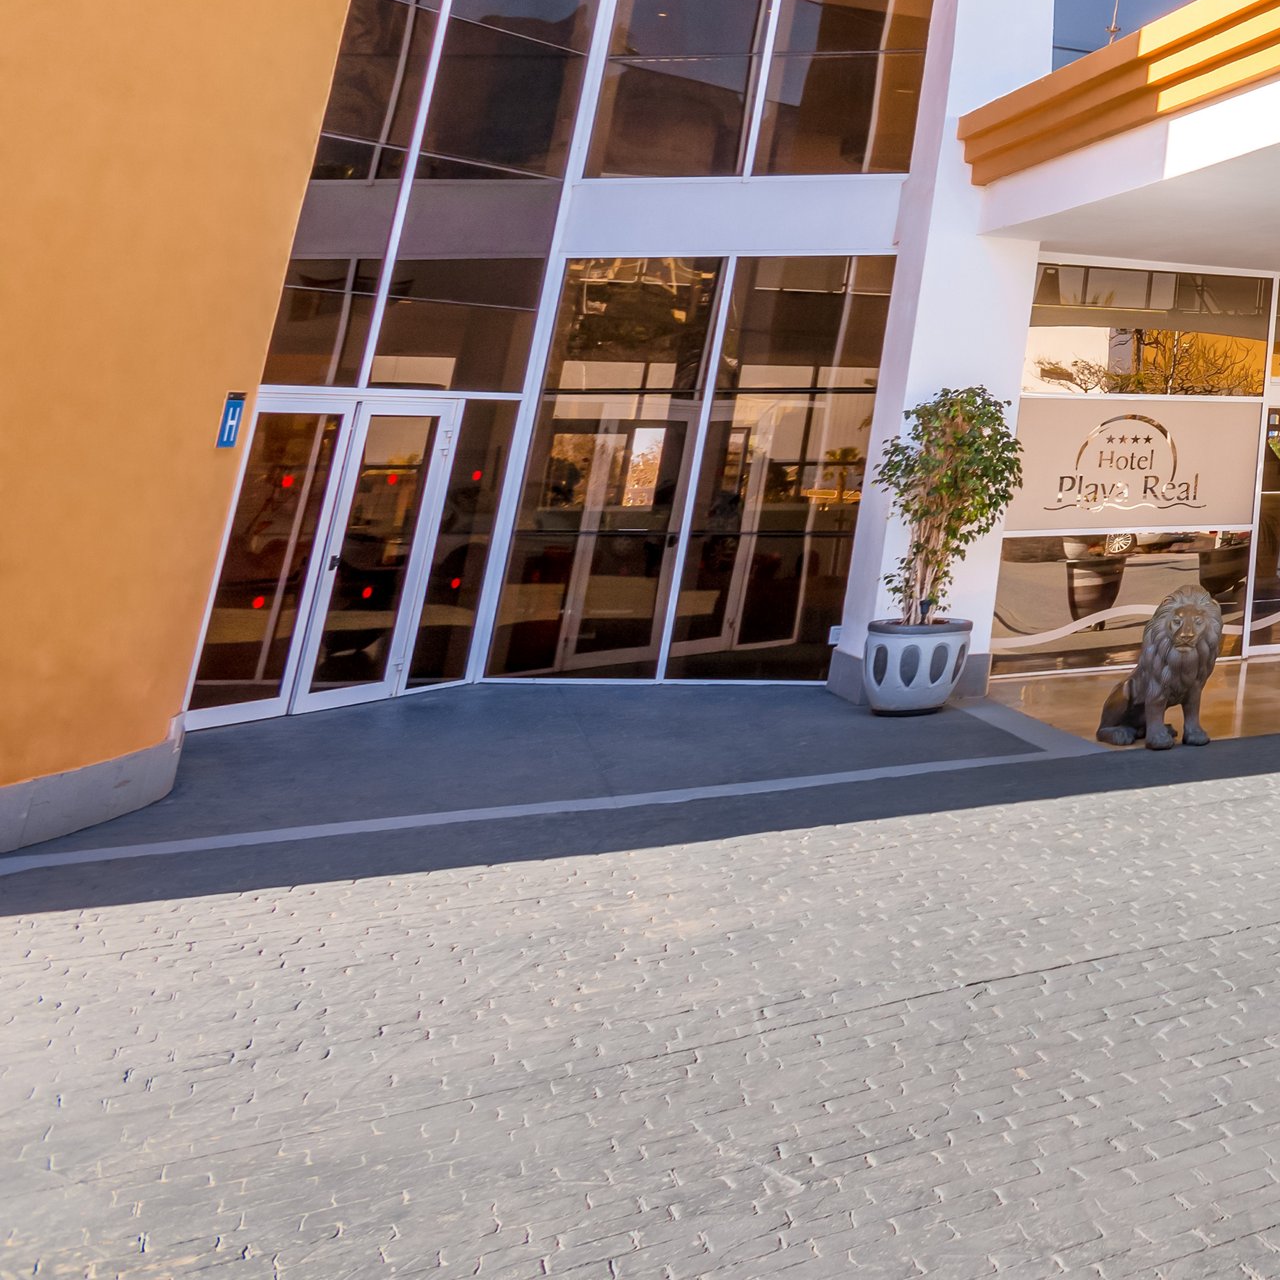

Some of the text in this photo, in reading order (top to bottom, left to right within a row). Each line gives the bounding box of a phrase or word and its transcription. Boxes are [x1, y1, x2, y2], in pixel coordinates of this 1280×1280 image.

[222, 406, 241, 442] H
[1098, 449, 1155, 471] Hotel
[1056, 473, 1199, 512] Playa Real
